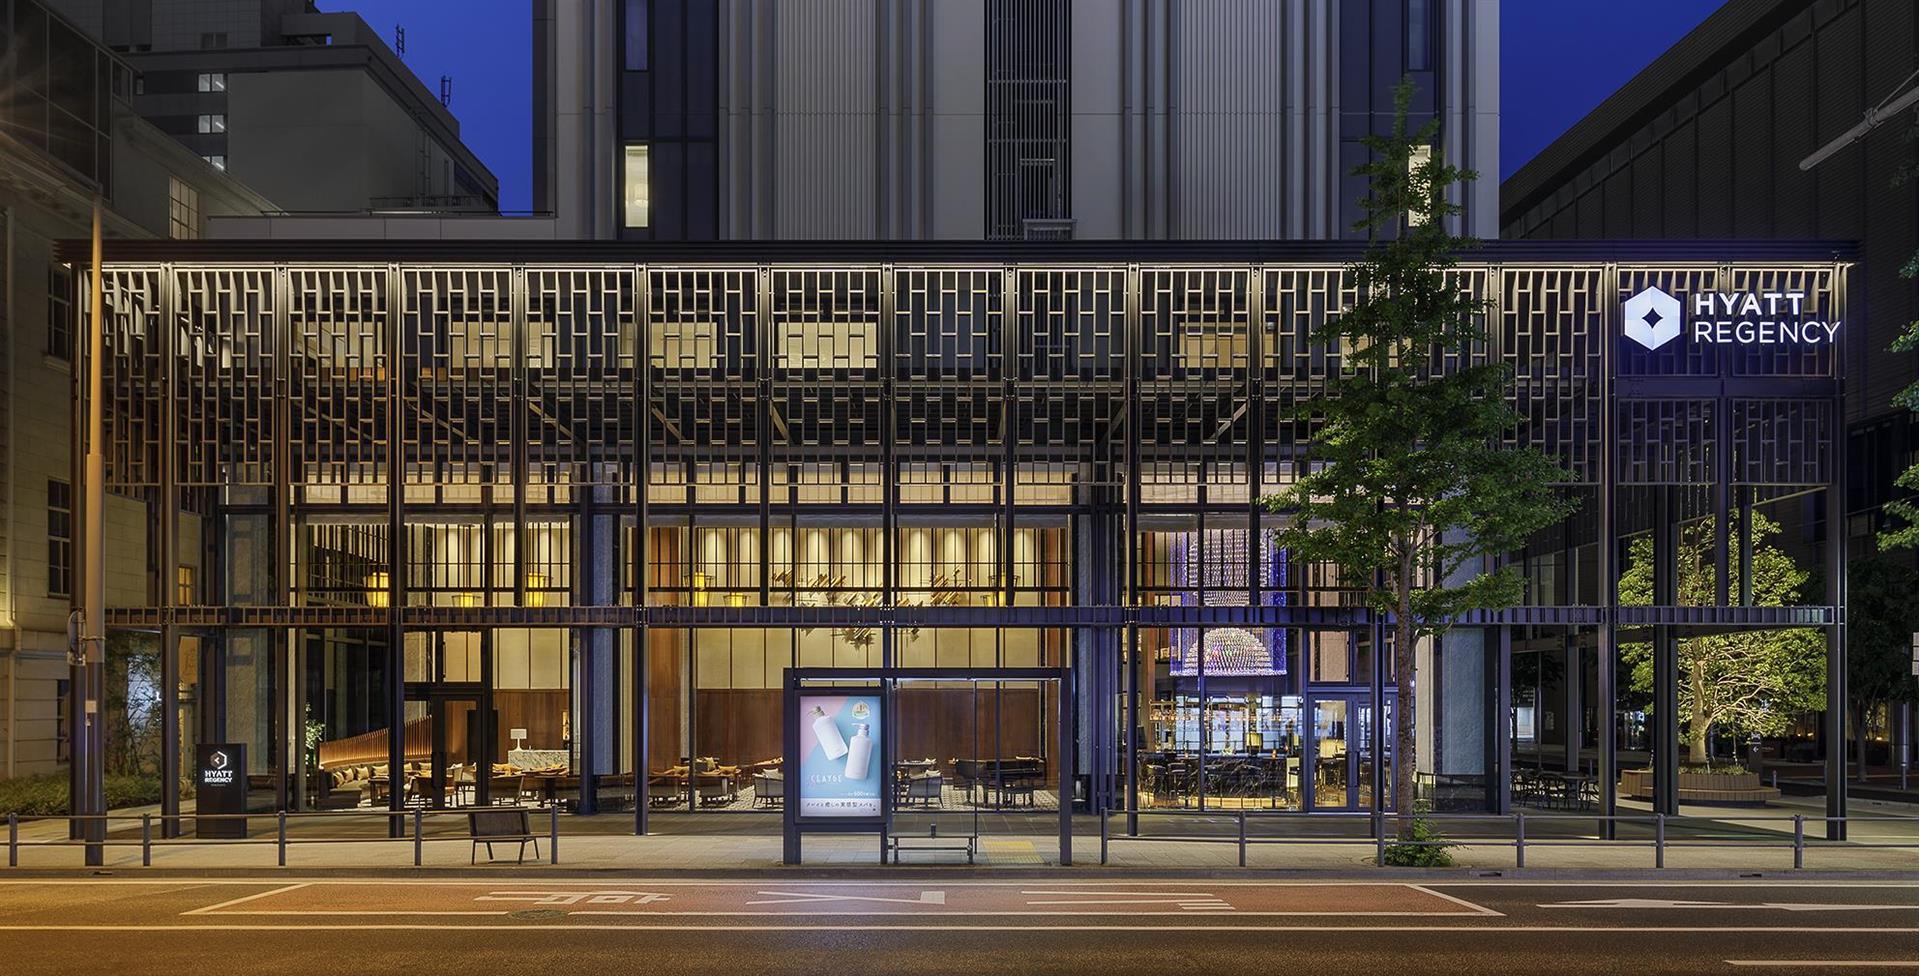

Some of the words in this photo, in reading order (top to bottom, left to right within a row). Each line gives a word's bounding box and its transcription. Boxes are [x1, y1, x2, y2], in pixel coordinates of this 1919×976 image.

[1695, 293, 1804, 316] HYATT
[1695, 321, 1841, 344] REGENCY
[204, 770, 233, 778] HYATT
